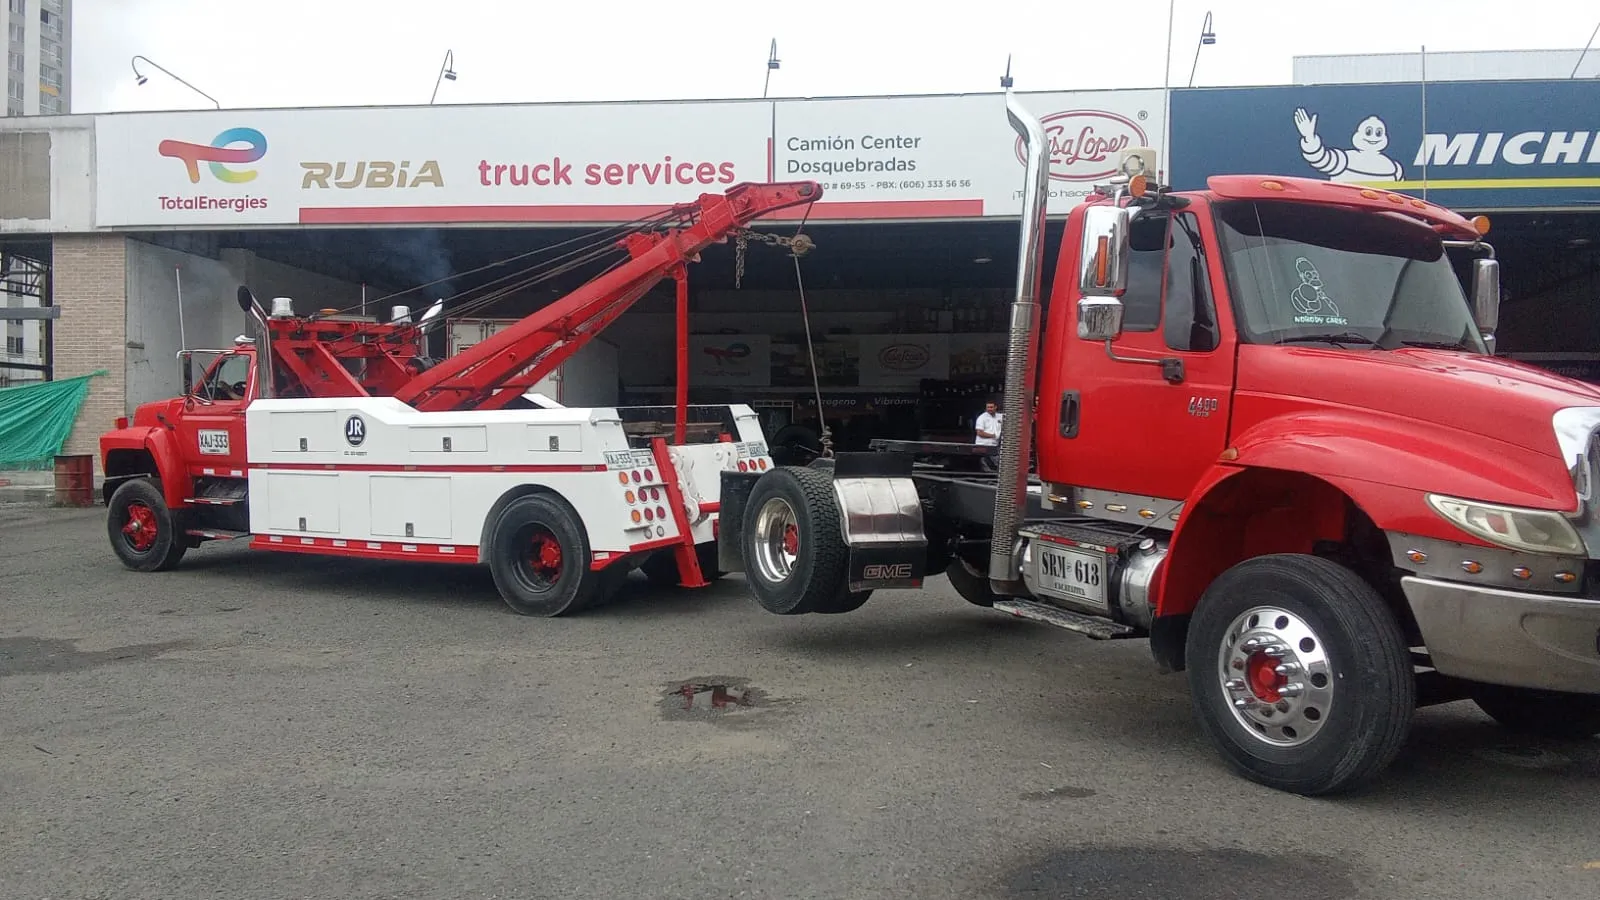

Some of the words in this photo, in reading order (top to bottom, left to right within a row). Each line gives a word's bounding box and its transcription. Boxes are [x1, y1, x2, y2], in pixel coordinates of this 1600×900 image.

[787, 136, 855, 151] Camión
[861, 135, 921, 149] Center
[479, 157, 572, 186] truck
[585, 155, 735, 185] services
[787, 157, 916, 175] Dosquebradas
[840, 182, 866, 190] 69-55
[899, 180, 925, 189] (606)
[927, 180, 943, 188] 333
[946, 180, 957, 188] 56
[158, 196, 268, 213] TotalEnergies
[347, 418, 363, 436] JR
[863, 563, 913, 579] GMC
[1041, 550, 1067, 579] SRM
[1074, 559, 1100, 586] 613
